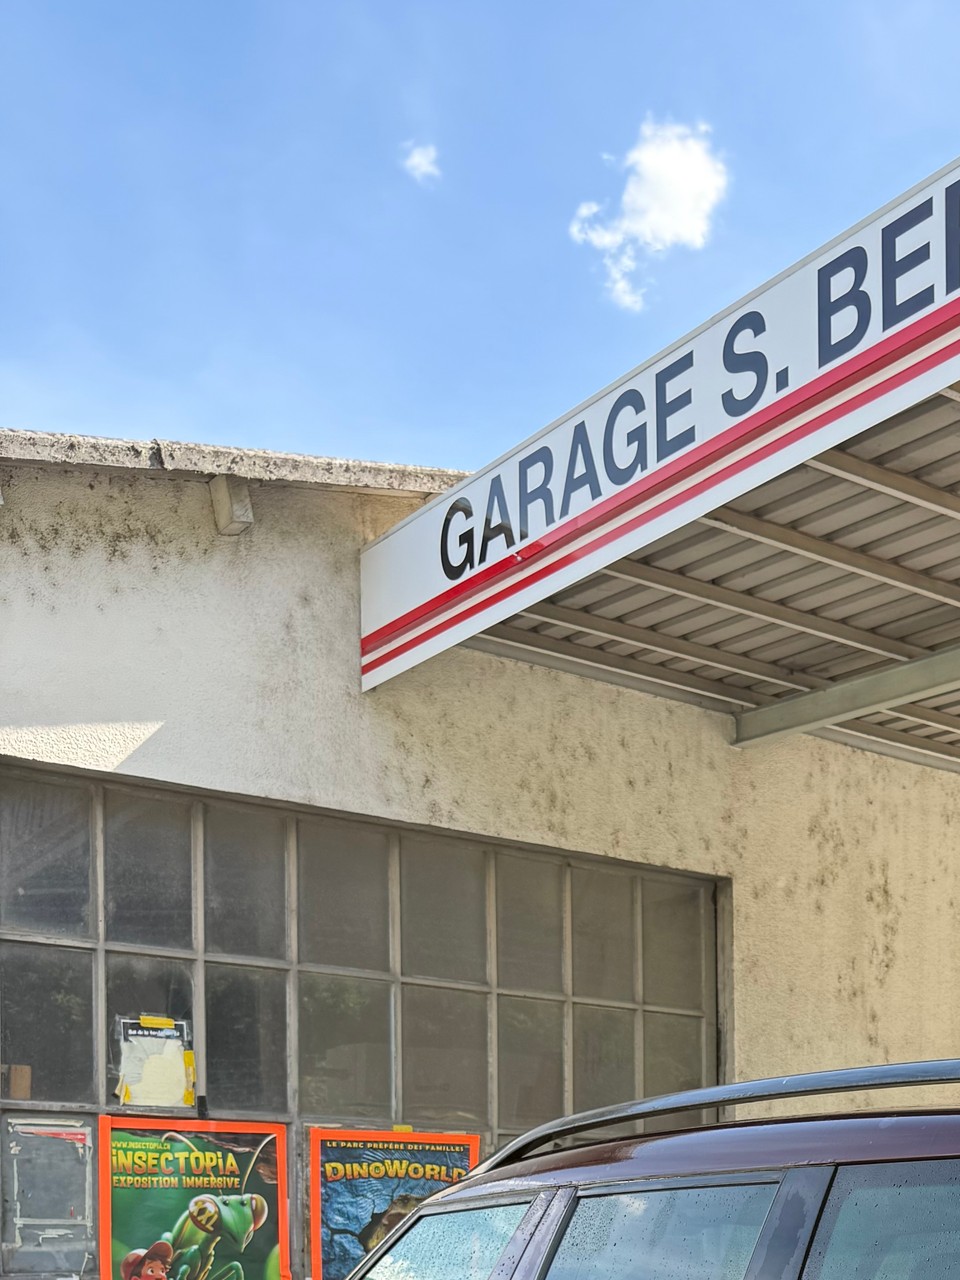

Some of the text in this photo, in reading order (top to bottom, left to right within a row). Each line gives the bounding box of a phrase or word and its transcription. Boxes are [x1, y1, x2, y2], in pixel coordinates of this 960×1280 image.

[440, 351, 696, 580] GARAGE
[721, 311, 789, 417] S.
[340, 1141, 364, 1149] PARC
[407, 1143, 423, 1151] DES
[425, 1144, 464, 1152] FAMILLES
